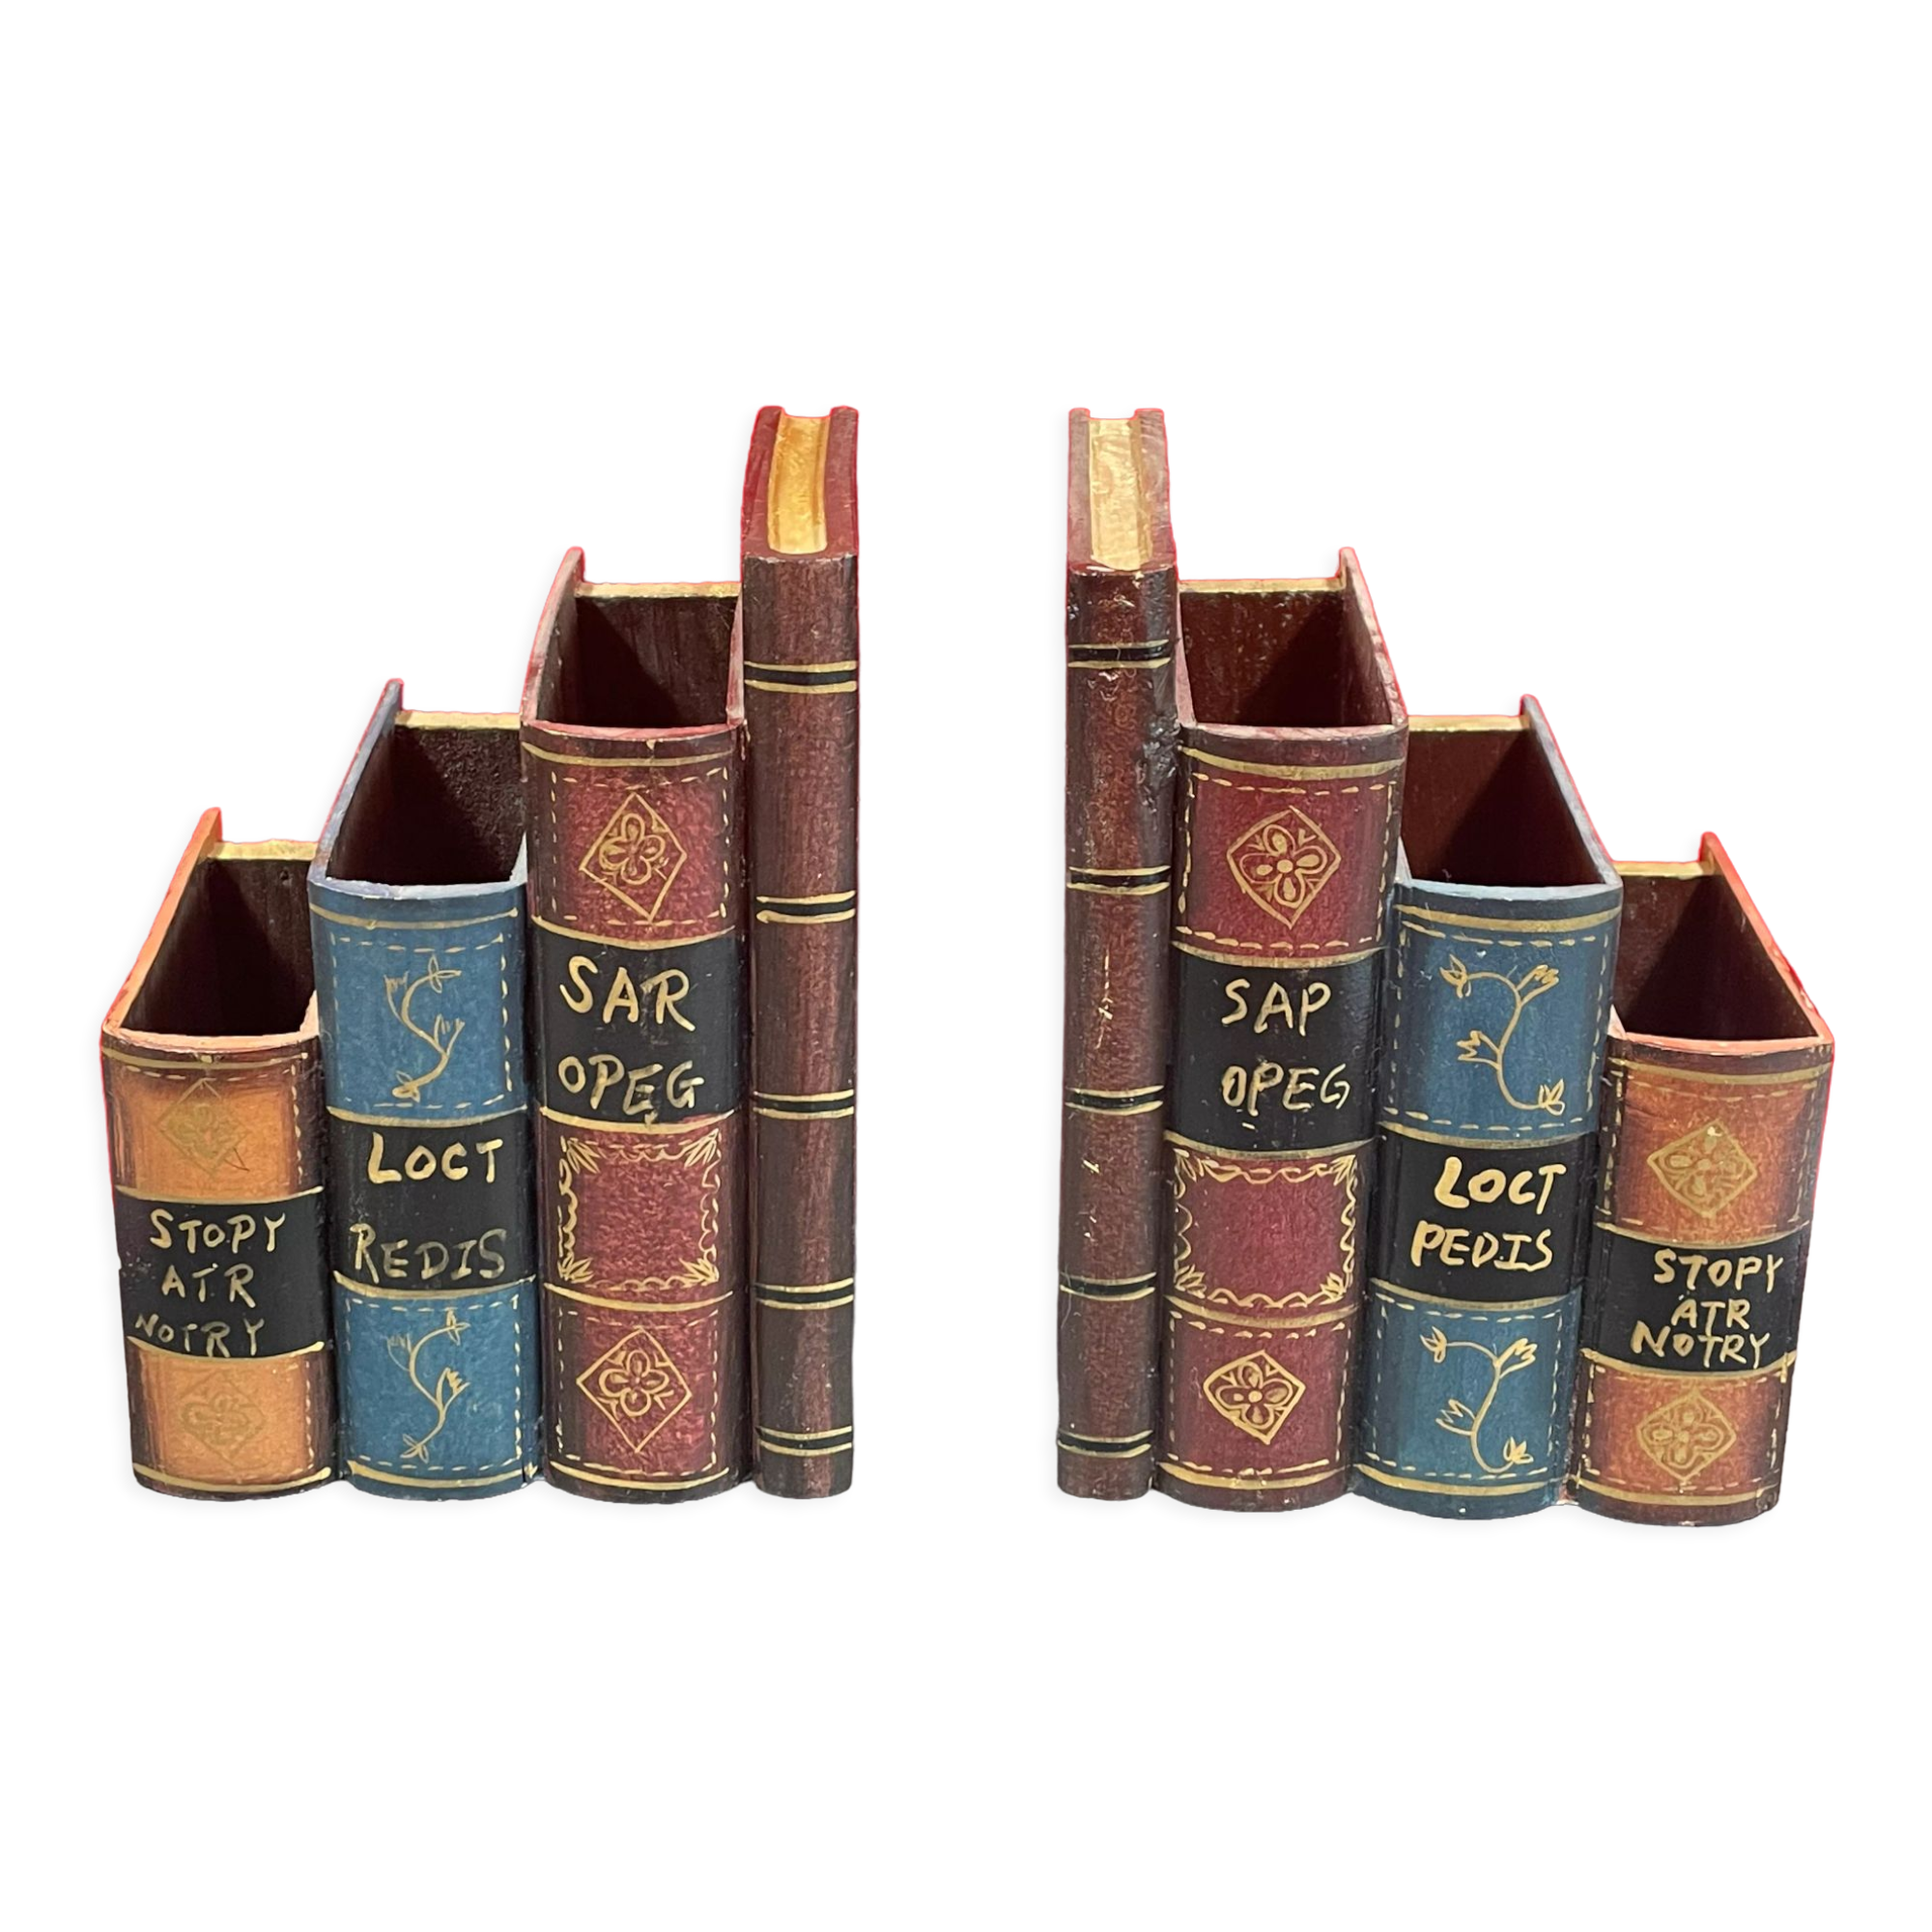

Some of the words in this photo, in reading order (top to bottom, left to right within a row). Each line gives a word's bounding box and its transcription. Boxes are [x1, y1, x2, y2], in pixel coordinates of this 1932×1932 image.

[559, 955, 696, 1032] SAR
[1221, 979, 1332, 1037] SAP
[557, 1054, 705, 1116] OPEG
[1221, 1062, 1350, 1117] OPEG
[367, 1131, 504, 1184] LOCT
[1434, 1155, 1567, 1215] LOCT
[150, 1208, 286, 1254] STOPY
[349, 1222, 507, 1284] REDIS
[1410, 1219, 1553, 1272] PEDIS
[161, 1263, 256, 1309] ATR
[1653, 1248, 1784, 1293] STOPY
[134, 1313, 265, 1357] NOTRY
[1670, 1298, 1750, 1332] ATR
[1630, 1321, 1771, 1369] NOTRY
